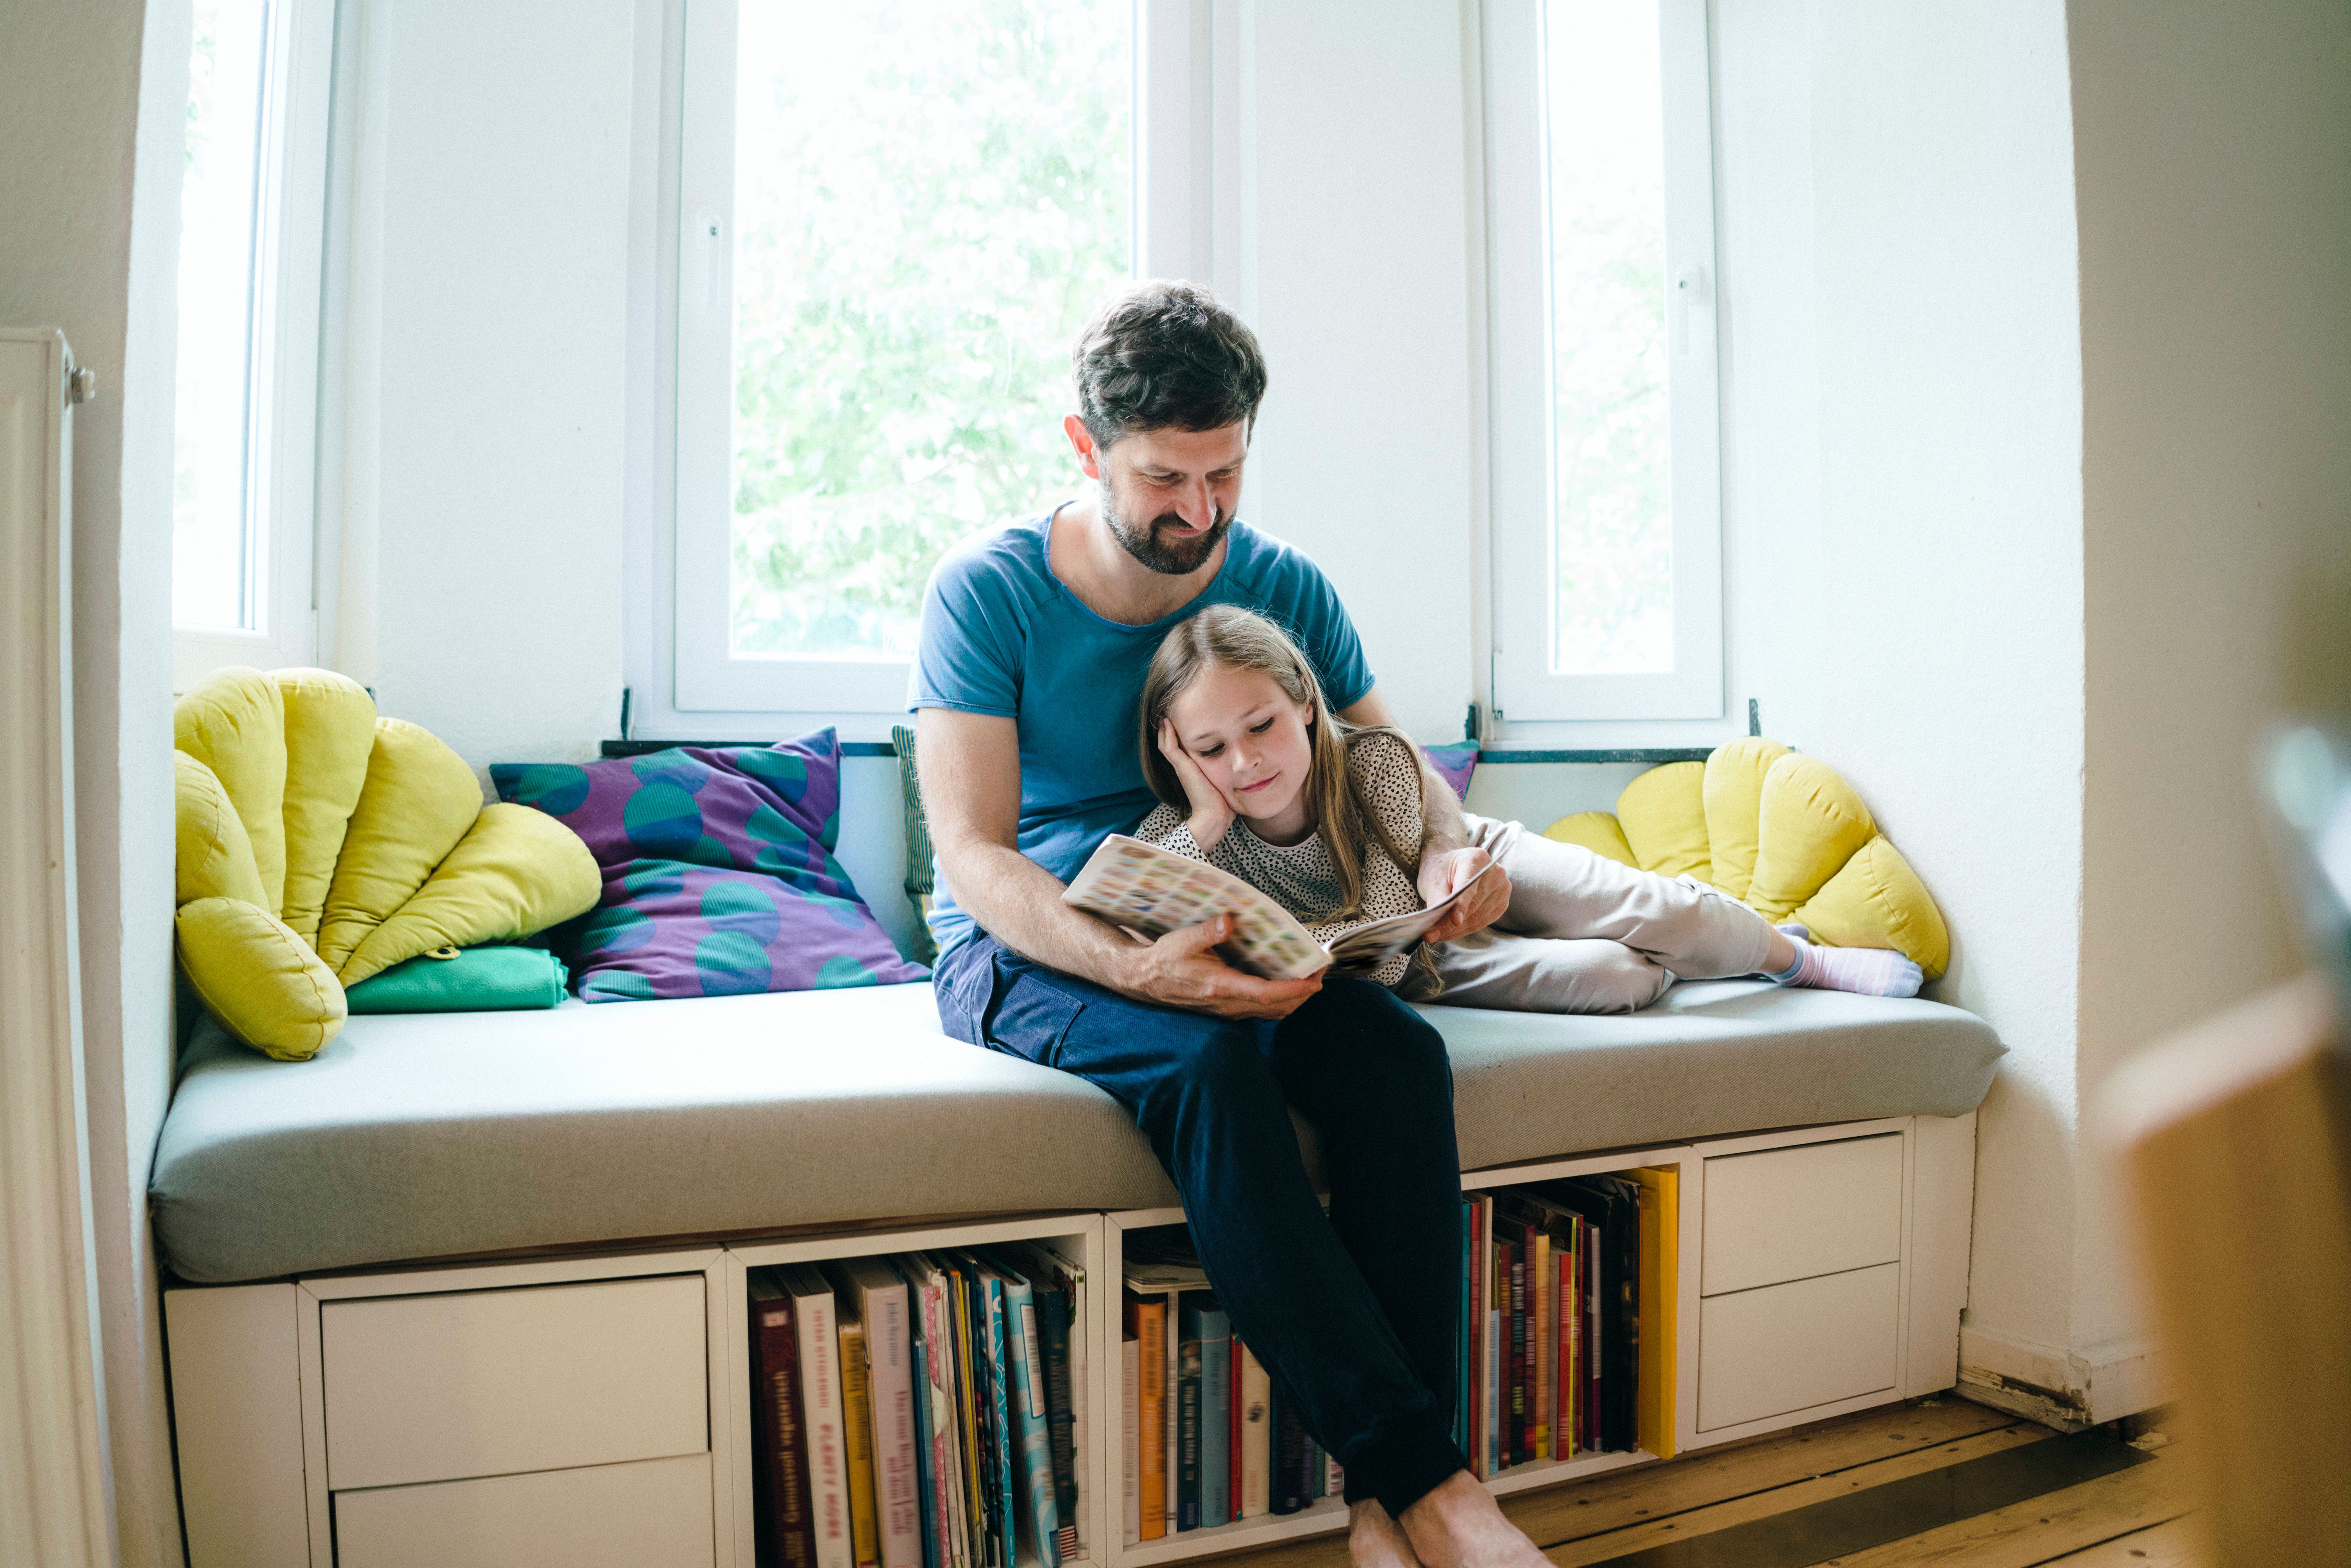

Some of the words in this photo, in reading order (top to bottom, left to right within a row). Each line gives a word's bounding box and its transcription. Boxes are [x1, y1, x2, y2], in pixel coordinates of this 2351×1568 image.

[813, 1309, 826, 1342] YOTAM
[772, 1371, 797, 1447] vegetarisch
[819, 1423, 838, 1486] PLENTY
[778, 1451, 801, 1523] Genussvoll
[824, 1493, 842, 1539] MORE
